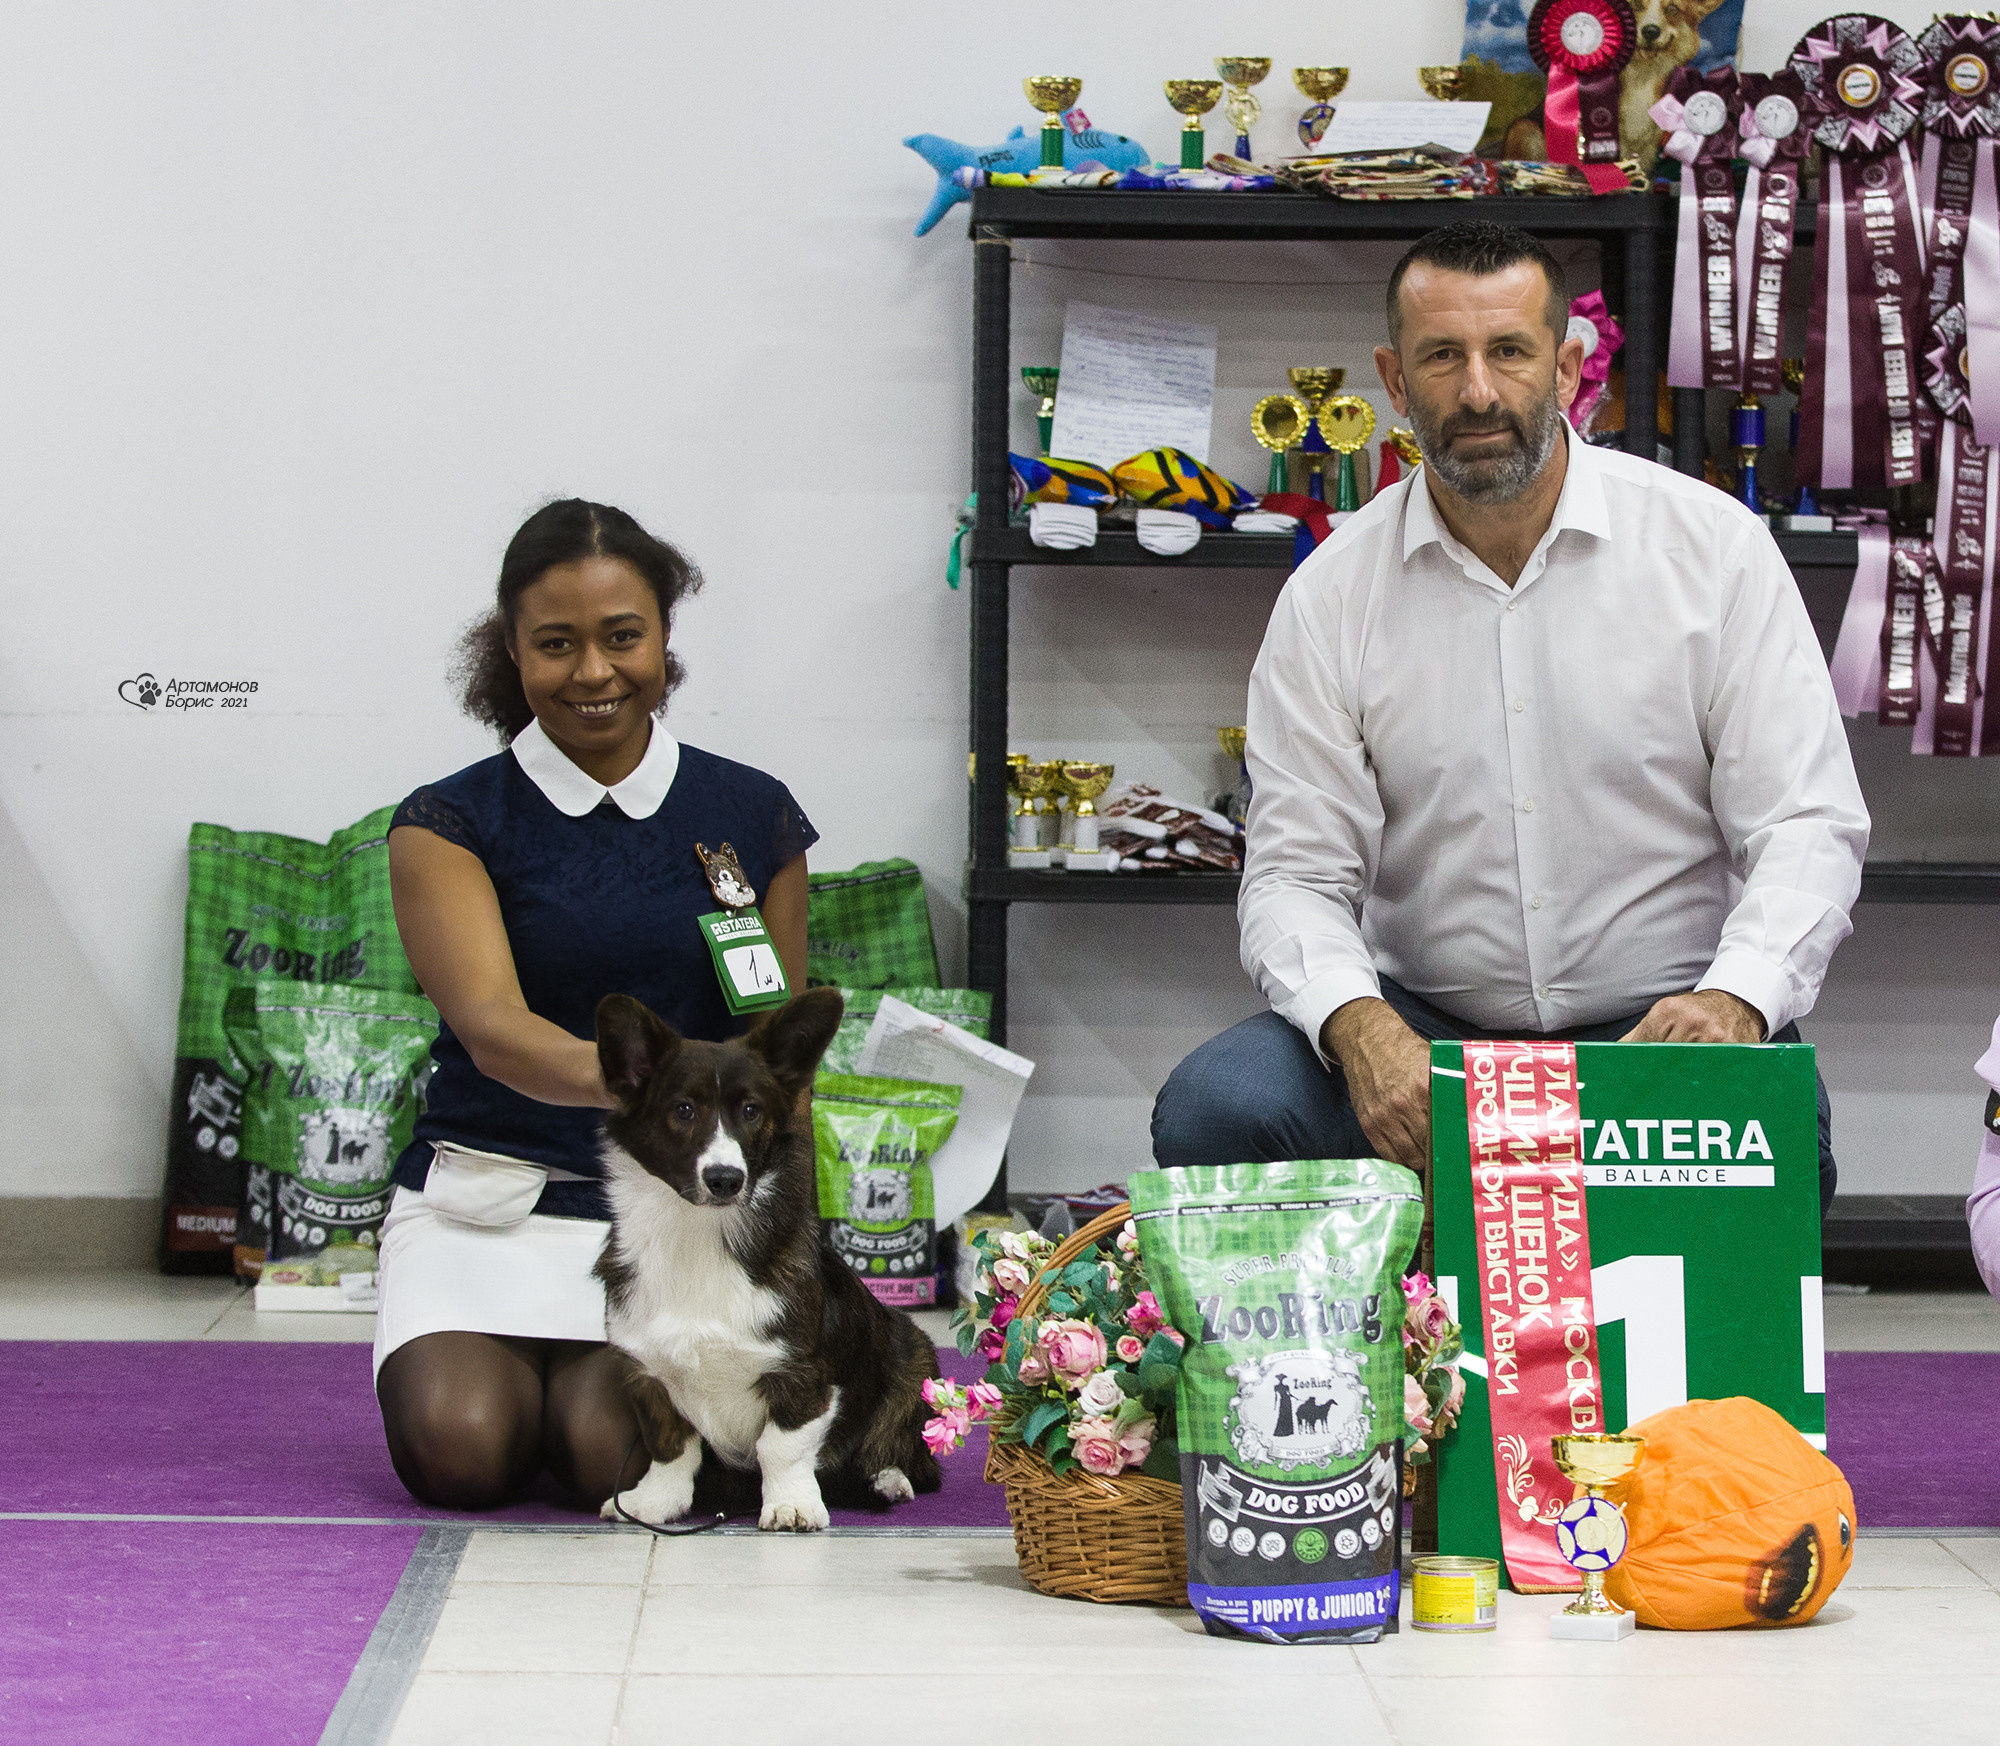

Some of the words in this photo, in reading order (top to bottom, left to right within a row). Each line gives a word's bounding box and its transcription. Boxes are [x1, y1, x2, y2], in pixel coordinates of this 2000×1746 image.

[1707, 255, 1732, 351] WINNER
[1753, 264, 1783, 360] WINNER
[1888, 594, 1917, 690] WINNER
[719, 916, 762, 933] STATERA
[1580, 1119, 1774, 1160] TATERA
[1541, 1042, 1582, 1283] ТЛАНТИДА»,
[1605, 1168, 1727, 1183] BALANCE
[303, 1197, 337, 1217] DOG
[340, 1200, 382, 1218] FOOD
[851, 1235, 876, 1249] DOG
[877, 1236, 908, 1250] FOOD
[1509, 1185, 1553, 1331] ЩЕНОК
[868, 1283, 894, 1293] CTIVE
[1223, 1255, 1273, 1287] SUPER
[1195, 1291, 1383, 1344] ZooRing
[1484, 1221, 1520, 1396] ВЫСТАВКИ
[1560, 1297, 1600, 1437] МОСКВ
[1246, 1486, 1300, 1515] DOG
[1304, 1481, 1365, 1515] FOOD
[1252, 1598, 1303, 1623] PUPPY
[1307, 1596, 1319, 1620] &
[1321, 1591, 1377, 1619] JUNIOR
